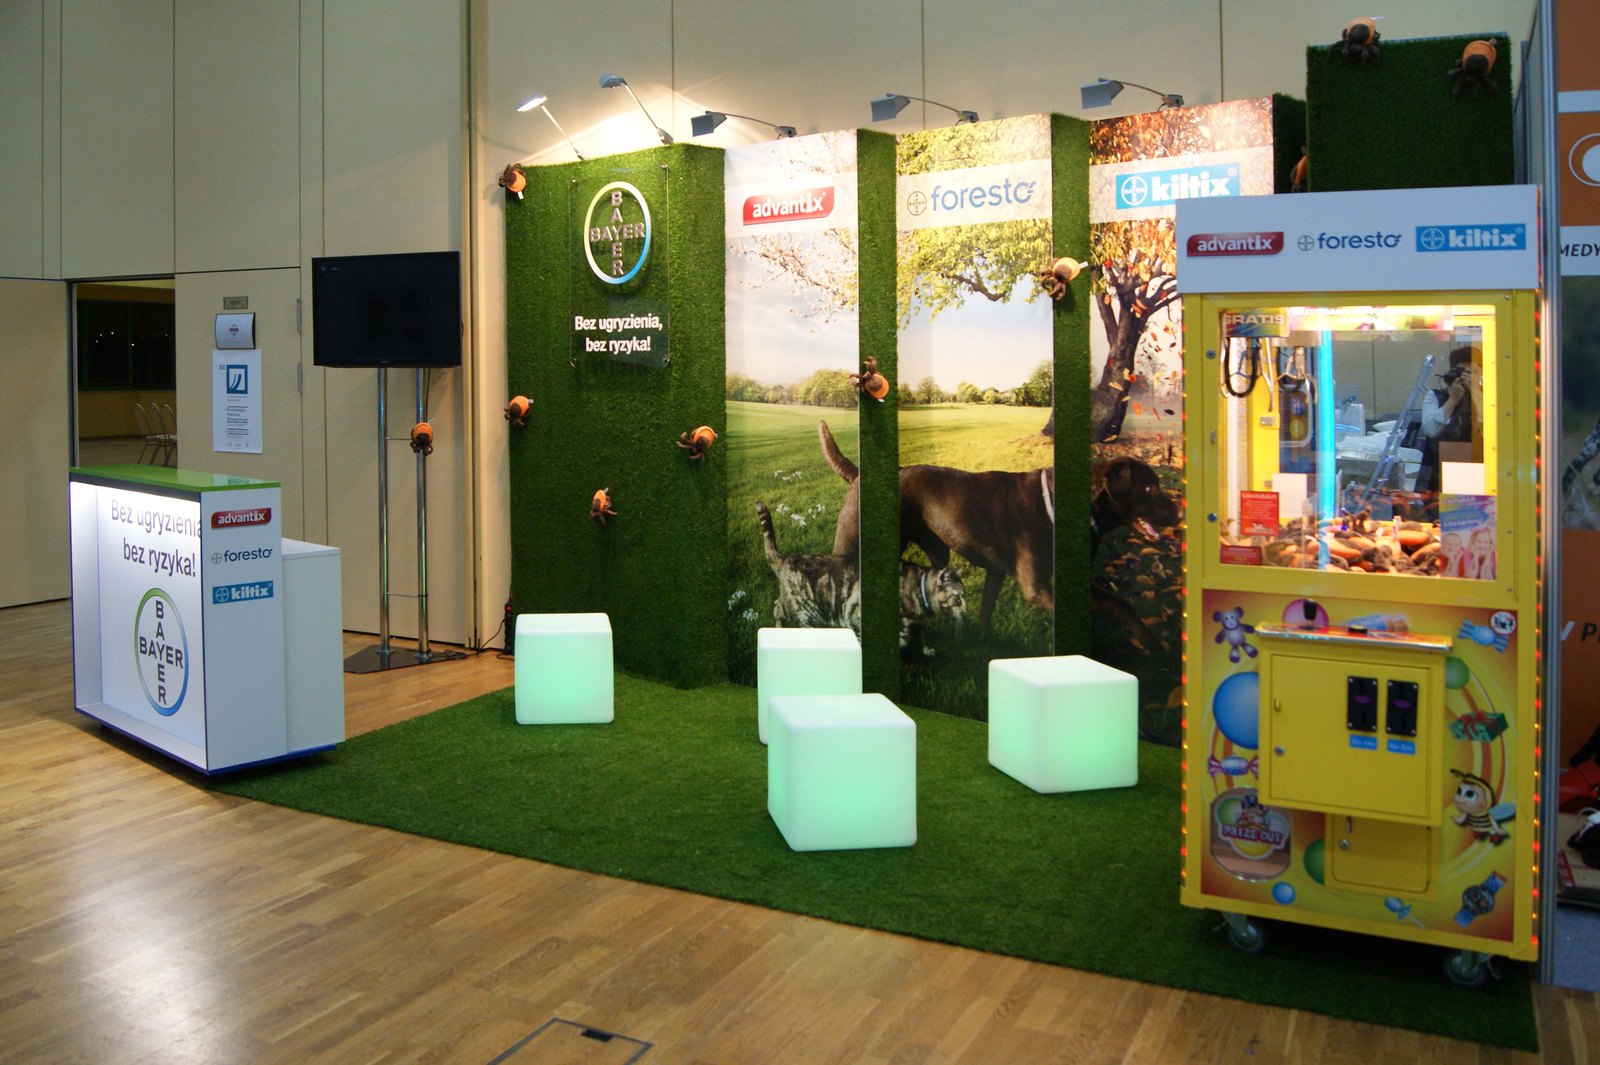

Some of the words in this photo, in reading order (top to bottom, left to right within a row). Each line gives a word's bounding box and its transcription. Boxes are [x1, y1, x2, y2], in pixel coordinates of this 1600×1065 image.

[931, 178, 1037, 211] foresto
[1151, 171, 1231, 201] kiltix
[752, 191, 824, 218] advantix
[589, 222, 646, 243] BAYER
[611, 190, 624, 275] BAYER
[1197, 235, 1273, 251] advantix
[1318, 232, 1401, 249] foresto
[1449, 228, 1517, 248] kiltix
[574, 315, 596, 331] Bez
[598, 313, 663, 333] ugryzienia,
[585, 337, 607, 352] bez
[609, 336, 651, 354] ryzyka!
[111, 499, 133, 524] Bez
[218, 510, 265, 525] advantix
[123, 537, 145, 564] bez
[149, 549, 196, 577] ryzyka!
[223, 547, 273, 562] foresto
[231, 584, 269, 600] kiltix
[139, 636, 184, 669] BAYER
[155, 600, 167, 705] BAYER
[1261, 831, 1282, 844] OUT
